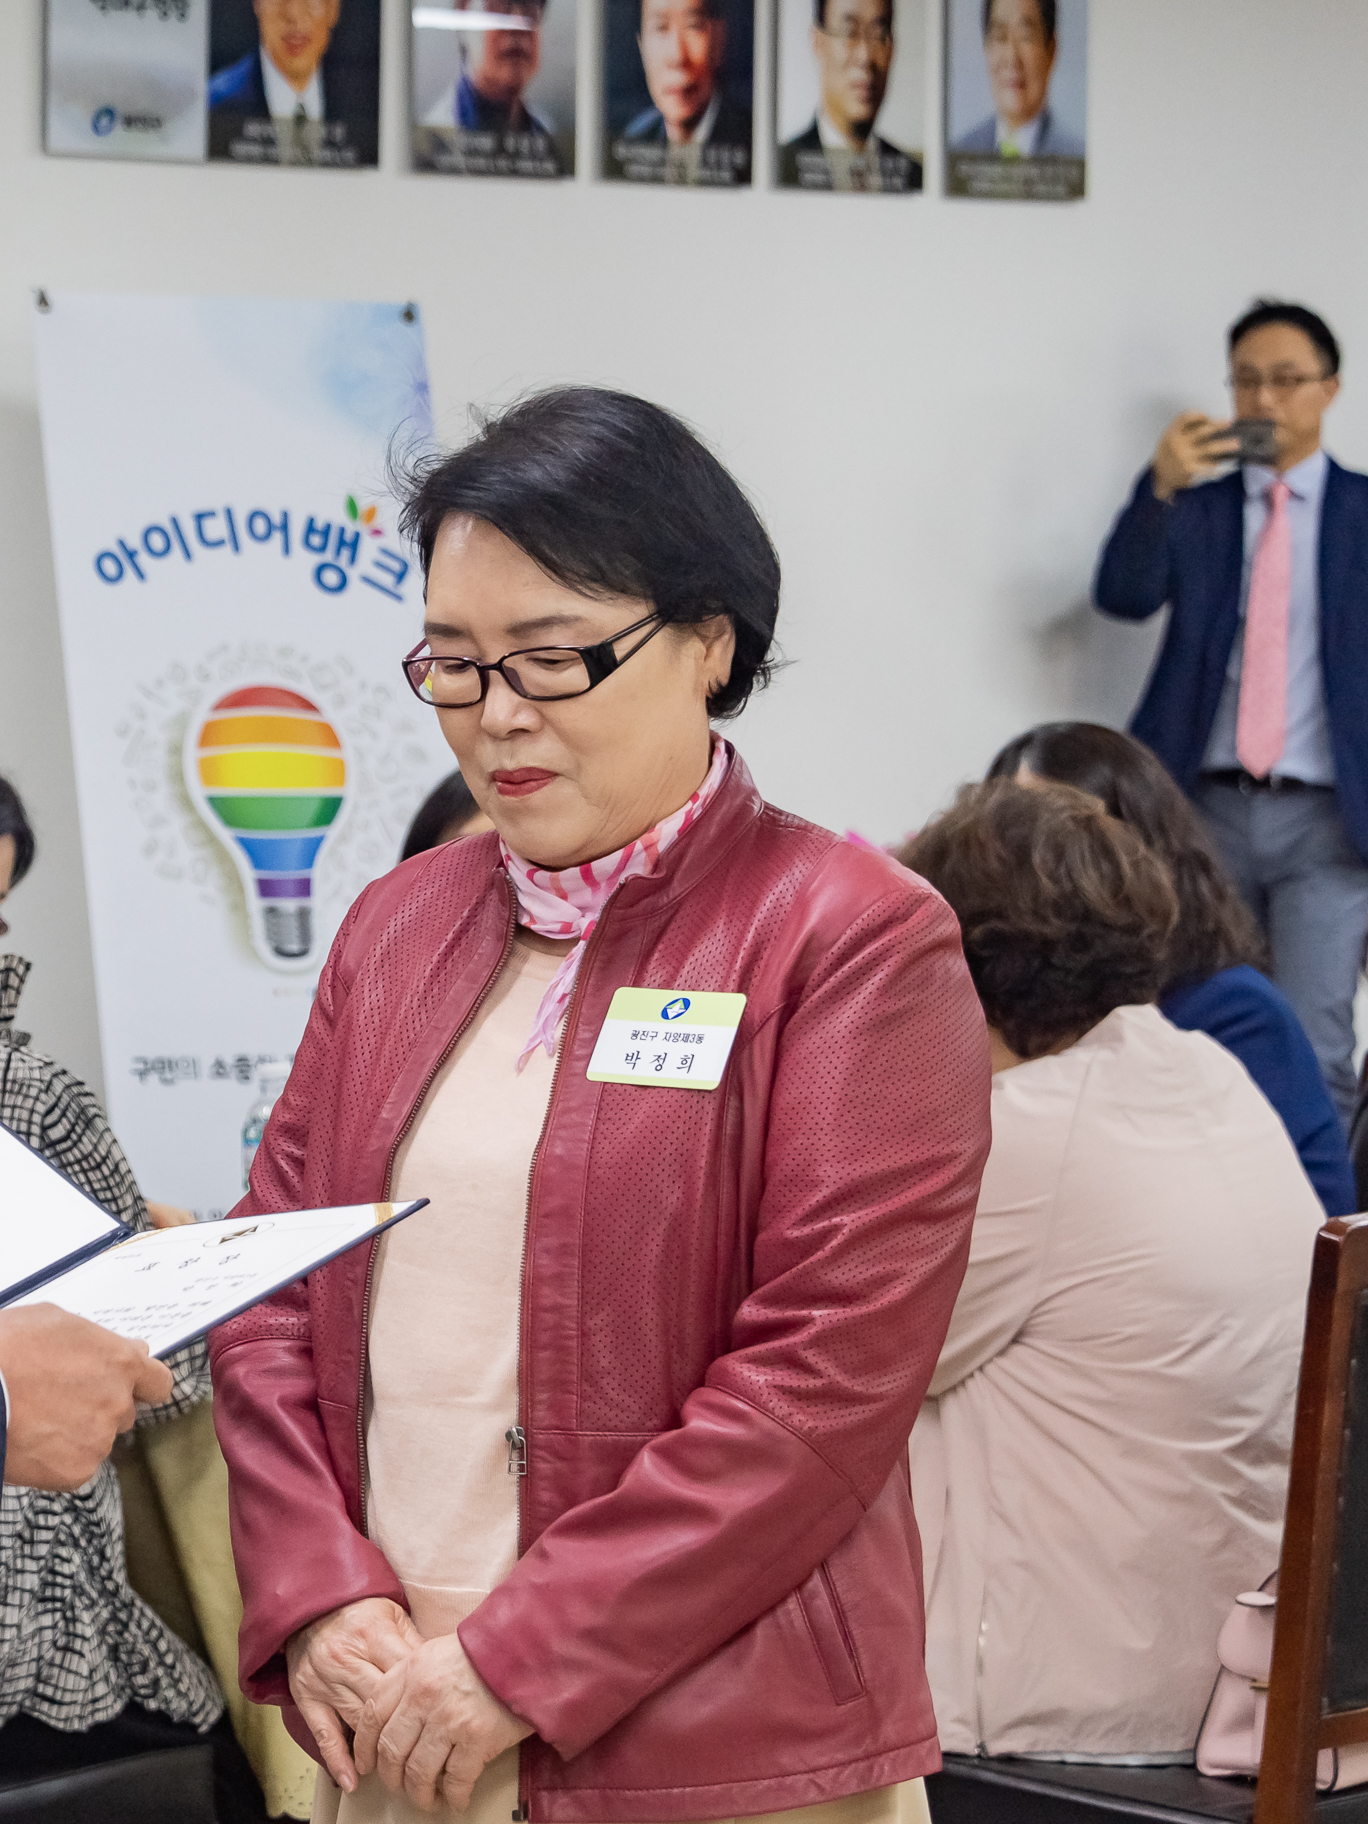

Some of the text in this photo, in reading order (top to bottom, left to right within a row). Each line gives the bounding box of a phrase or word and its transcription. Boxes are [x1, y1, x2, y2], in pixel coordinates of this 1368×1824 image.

[92, 504, 412, 604] 아이디어뱅크
[630, 1030, 706, 1045] 광진구 자양제3동
